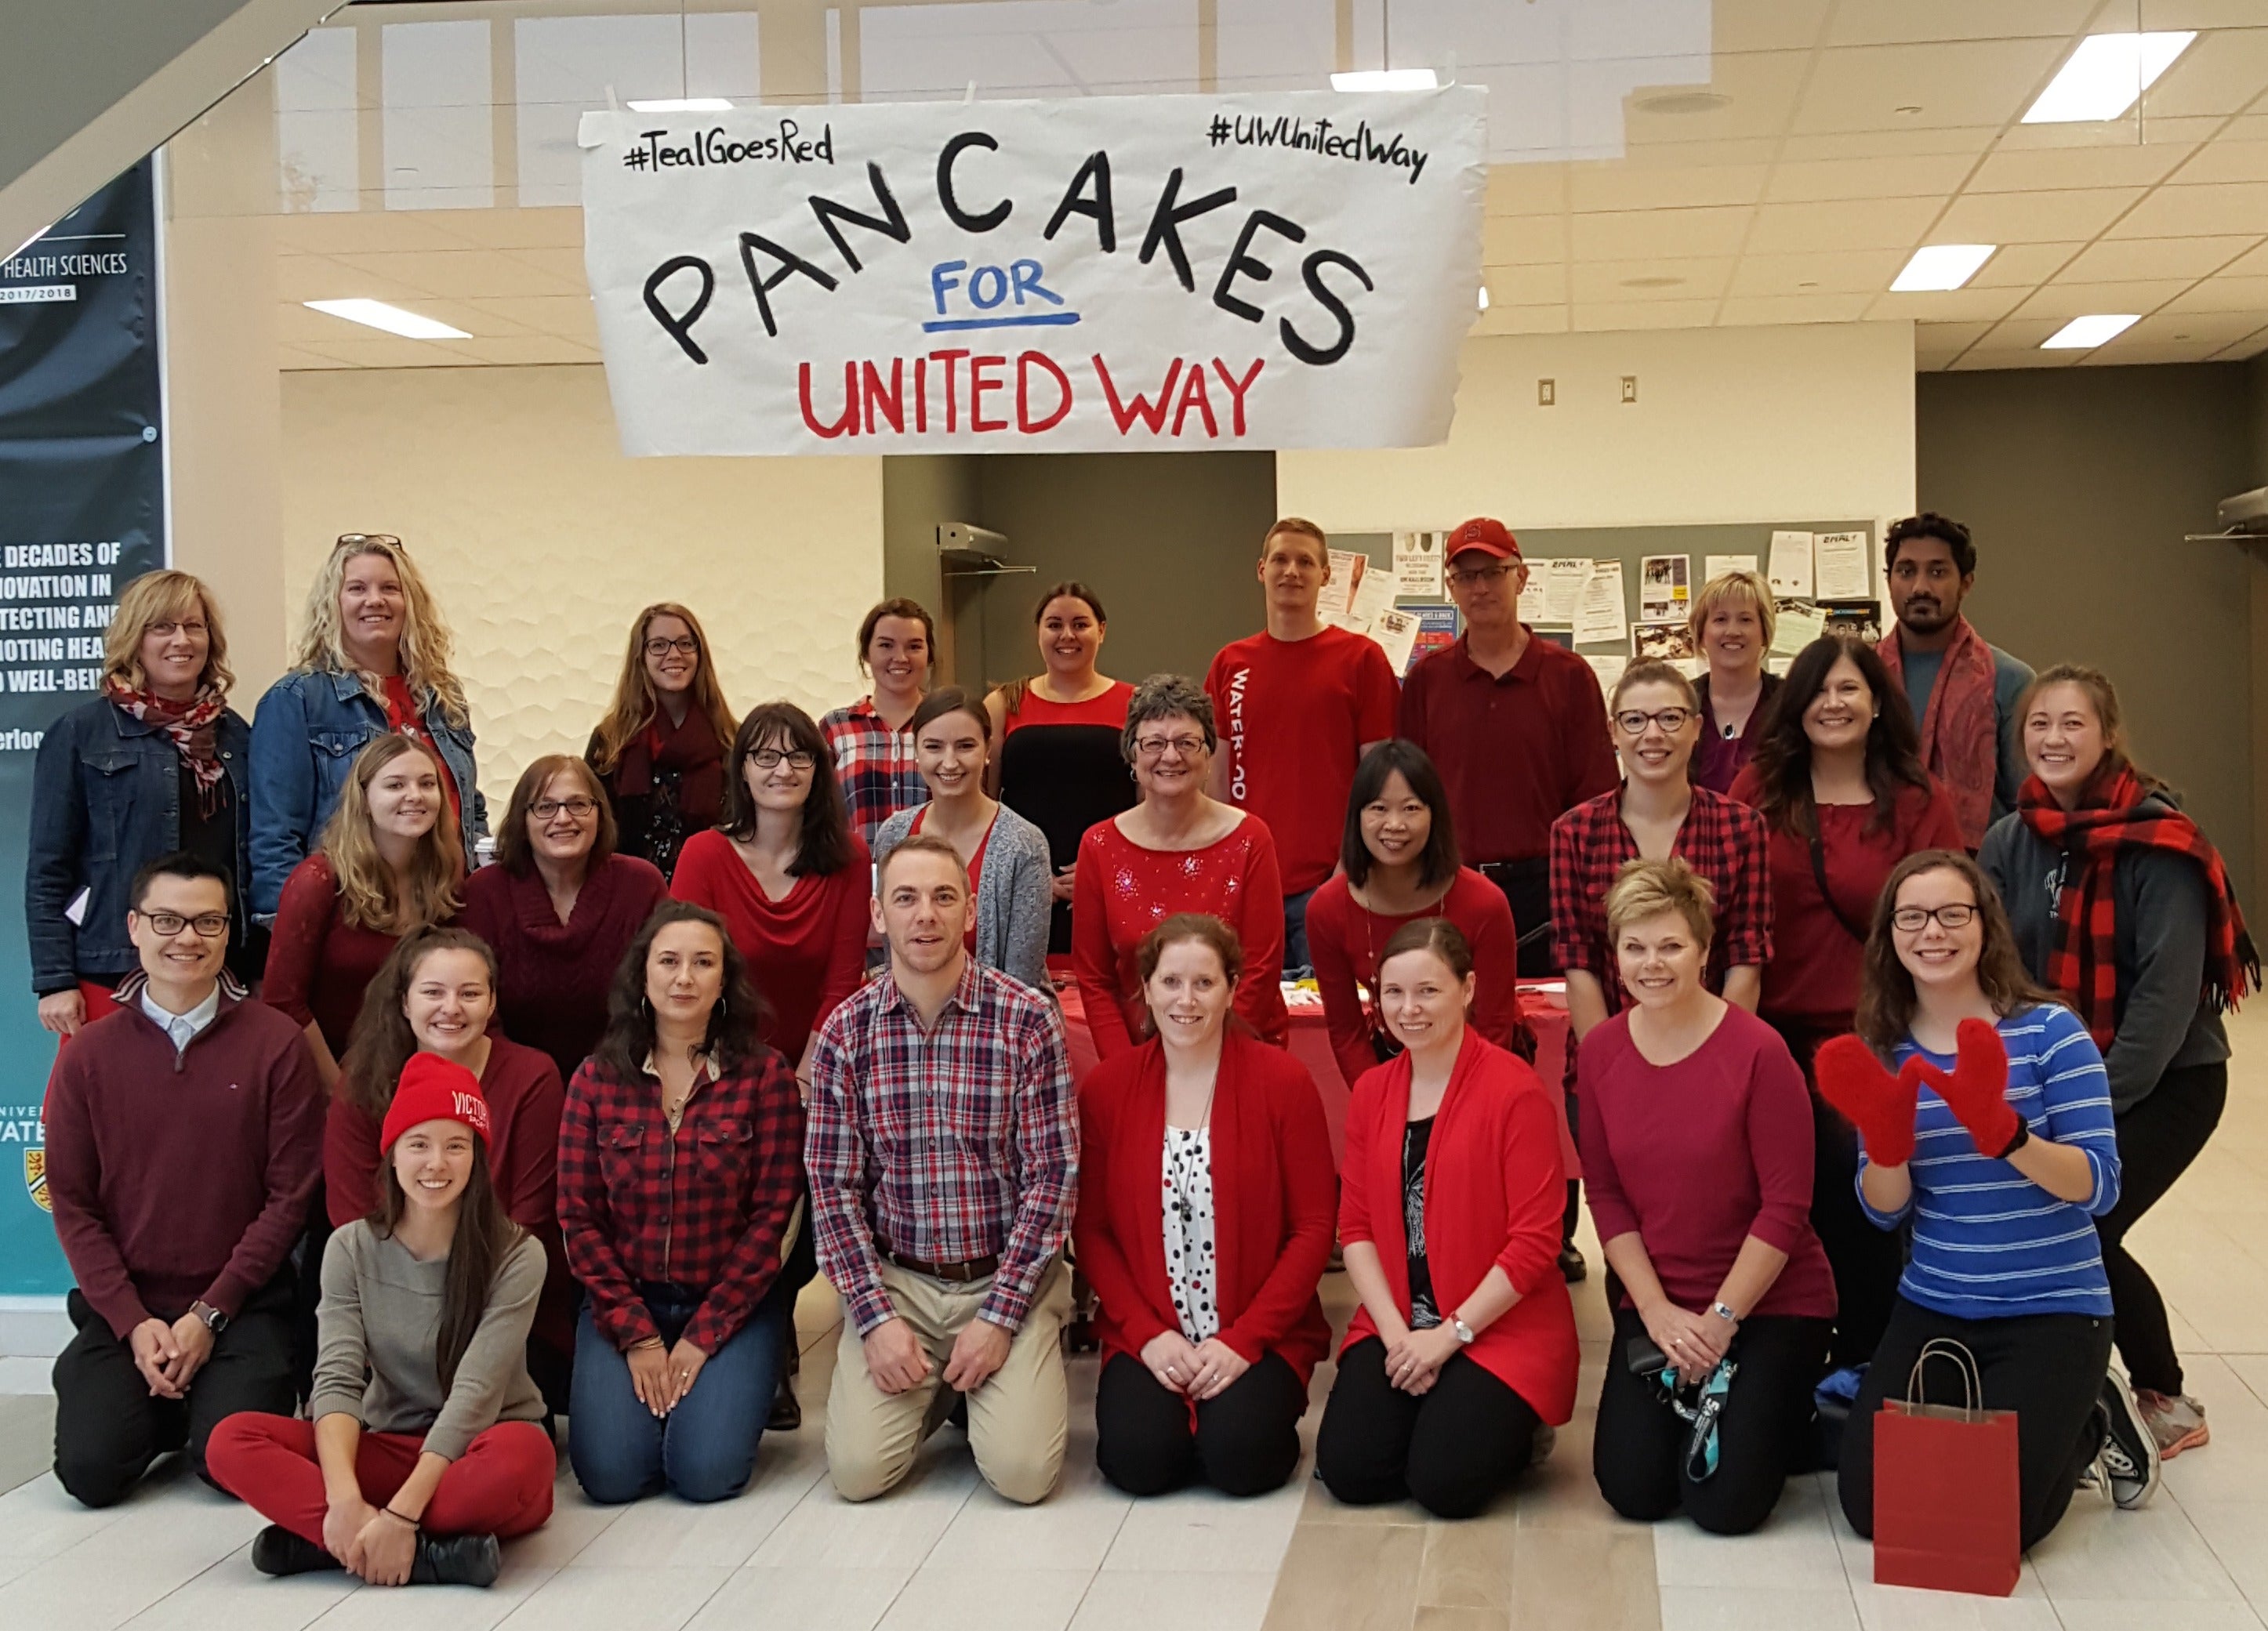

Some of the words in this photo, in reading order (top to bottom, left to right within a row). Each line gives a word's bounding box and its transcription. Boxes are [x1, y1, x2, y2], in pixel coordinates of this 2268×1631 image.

[623, 119, 834, 172] #TealGoesRed
[1206, 114, 1428, 183] #UWUnitedWay
[643, 132, 1374, 366] PANCAKES
[5, 256, 56, 278] HEALTH
[60, 253, 128, 275] SCIENCES
[0, 288, 71, 300] 2017/2018
[931, 259, 1065, 314] FOR
[799, 350, 1072, 438] UNITED
[1092, 353, 1265, 438] WAY
[5, 543, 93, 568] DECADES
[96, 542, 121, 565] OF
[92, 574, 112, 597] IN
[0, 638, 64, 661] OTING
[67, 636, 107, 660] HEA
[0, 1121, 45, 1142] ATE
